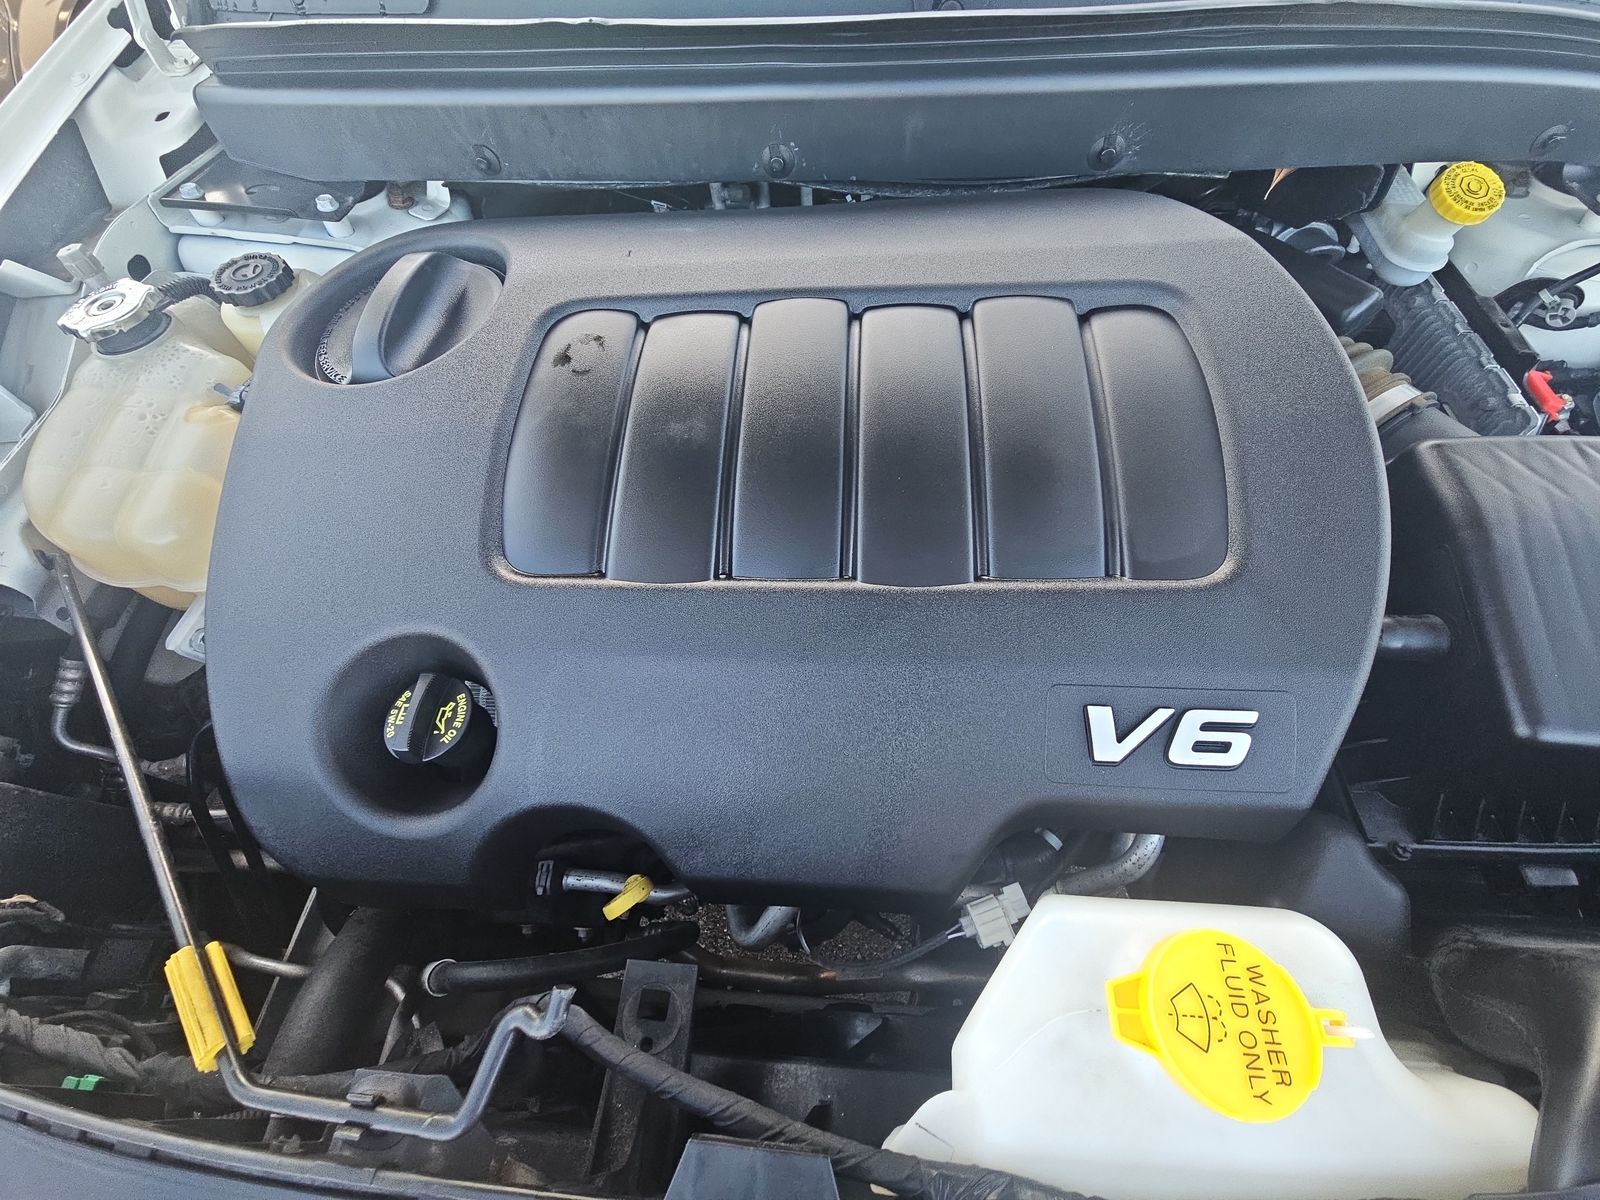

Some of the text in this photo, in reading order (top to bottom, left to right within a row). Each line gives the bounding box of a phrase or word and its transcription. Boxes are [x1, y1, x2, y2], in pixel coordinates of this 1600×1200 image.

[319, 355, 348, 384] SERVICE
[386, 690, 412, 738] SAE 5W-20
[439, 693, 467, 744] ENGINE OIL
[1084, 704, 1260, 770] V6
[1215, 942, 1273, 1106] FLUID ONLY
[1246, 964, 1293, 1088] WASHER
